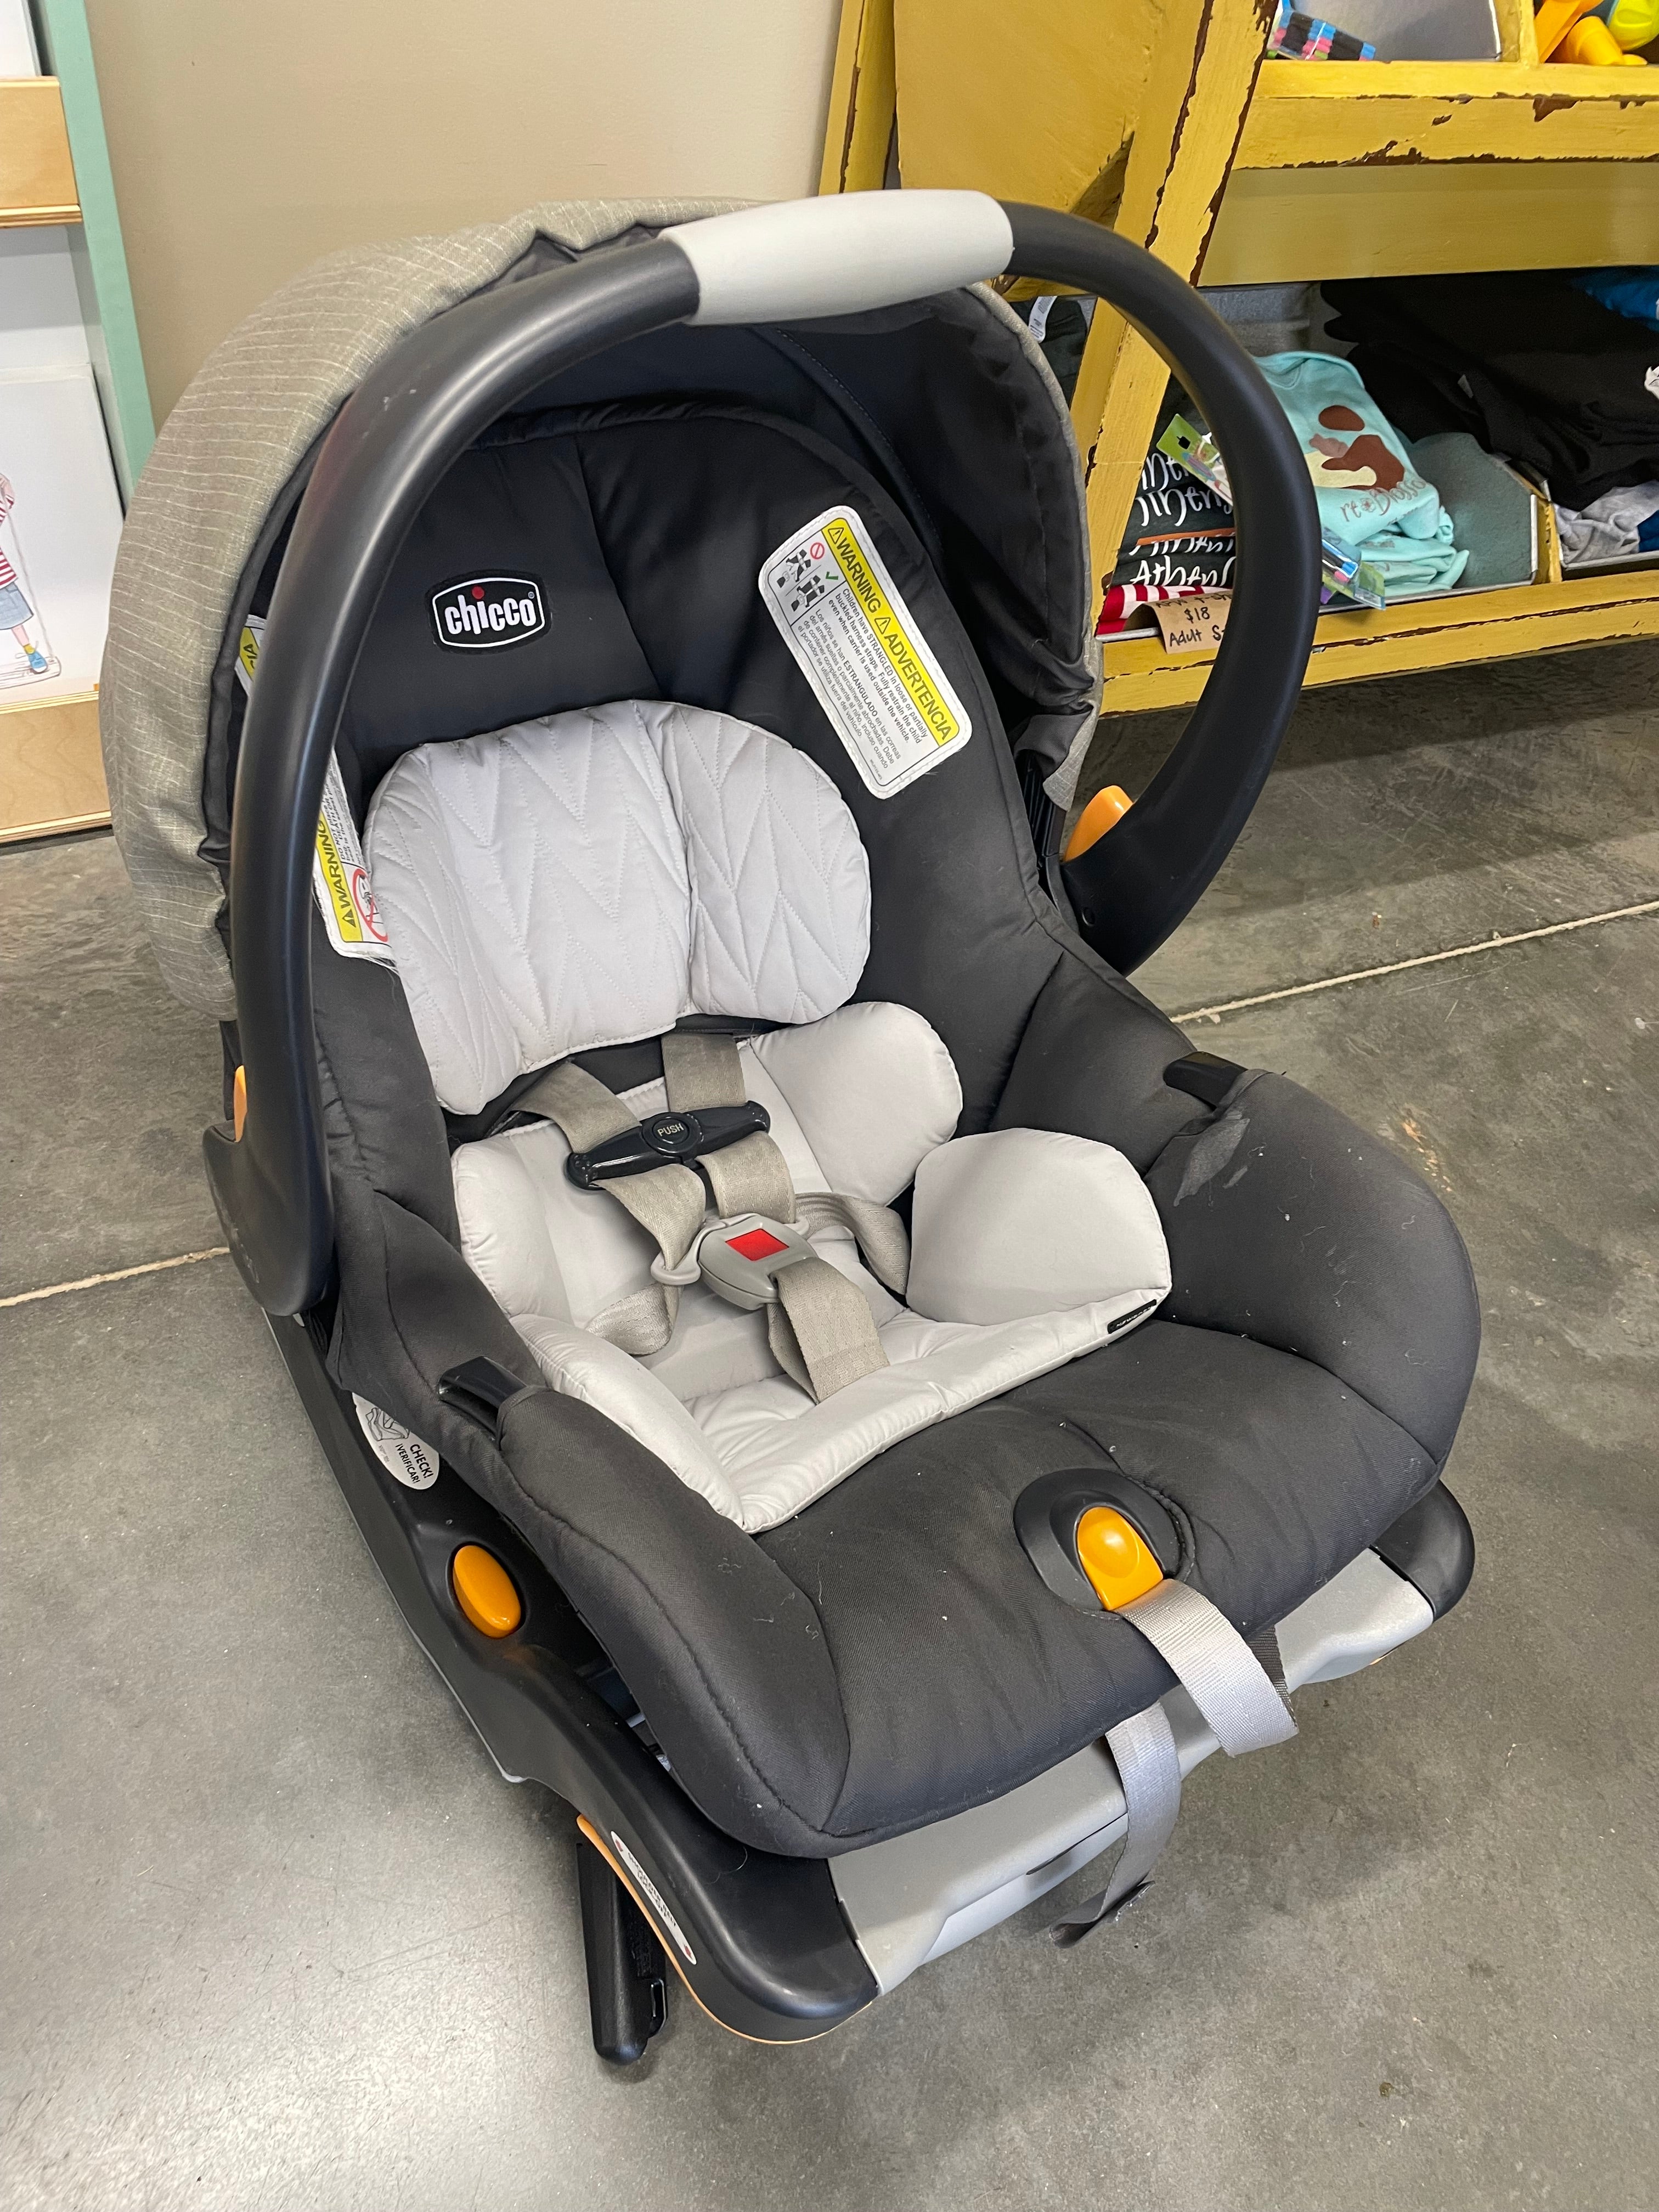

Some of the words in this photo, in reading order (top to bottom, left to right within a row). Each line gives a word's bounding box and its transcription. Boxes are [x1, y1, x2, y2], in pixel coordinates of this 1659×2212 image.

[837, 537, 881, 613] WARNING
[444, 585, 537, 635] chicco
[842, 588, 860, 618] Children
[1184, 607, 1210, 624] $18
[856, 615, 869, 635] have
[1170, 629, 1203, 647] Adult
[799, 631, 819, 658] portador
[820, 665, 832, 685] utiliza
[830, 683, 842, 701] fuera
[839, 700, 849, 712] del
[828, 599, 840, 617] even
[837, 615, 850, 635] when
[847, 633, 863, 657] carrier
[859, 655, 866, 664] is
[863, 663, 877, 681] used
[872, 680, 889, 706] outside
[886, 704, 896, 718] the
[893, 716, 910, 743] vehicle.
[834, 592, 854, 622] buckled
[849, 618, 866, 648] harness
[877, 670, 890, 690] Fully
[887, 689, 905, 716] restrain
[901, 714, 911, 727] the
[908, 726, 923, 744] child
[866, 633, 894, 676] STRANGLED
[808, 629, 826, 656] contener
[848, 701, 856, 709] al
[873, 745, 888, 769] cuando
[809, 614, 819, 626] del
[825, 642, 839, 667] sueltas
[838, 670, 864, 710] parcialmente
[882, 745, 895, 764] Debe
[815, 608, 825, 623] Los
[836, 646, 845, 662] han
[842, 659, 878, 717] ESTRANGULADO
[874, 716, 883, 727] en
[879, 724, 888, 737] las
[885, 736, 901, 760] correas
[884, 634, 952, 740] ADVERTENCIA
[889, 675, 897, 685] in
[893, 682, 908, 703] loose
[905, 703, 913, 712] or
[908, 710, 928, 740] partially
[317, 820, 351, 909] WARNING
[657, 1122, 684, 1137] PUSH
[410, 1443, 434, 1479] CHECK!
